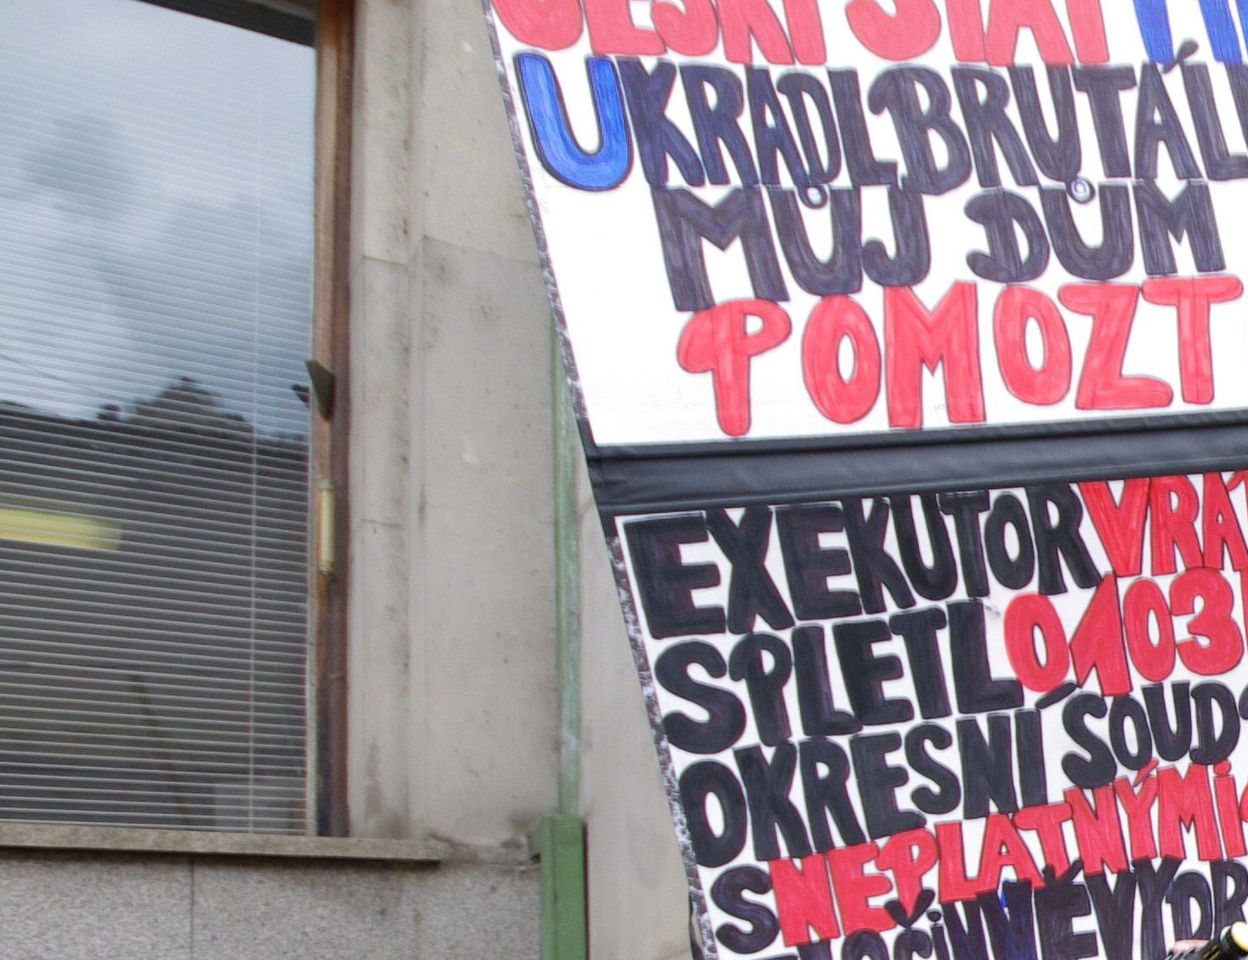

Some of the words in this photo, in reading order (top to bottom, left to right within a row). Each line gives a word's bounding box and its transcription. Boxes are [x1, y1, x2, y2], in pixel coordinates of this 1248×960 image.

[513, 51, 898, 192] UKRADL
[651, 184, 930, 311] MŮJ
[966, 177, 1226, 284] DŮM
[623, 483, 1103, 640] EXEKUTOR
[654, 599, 1025, 755] SPLETL
[1061, 680, 1241, 789] SOUD
